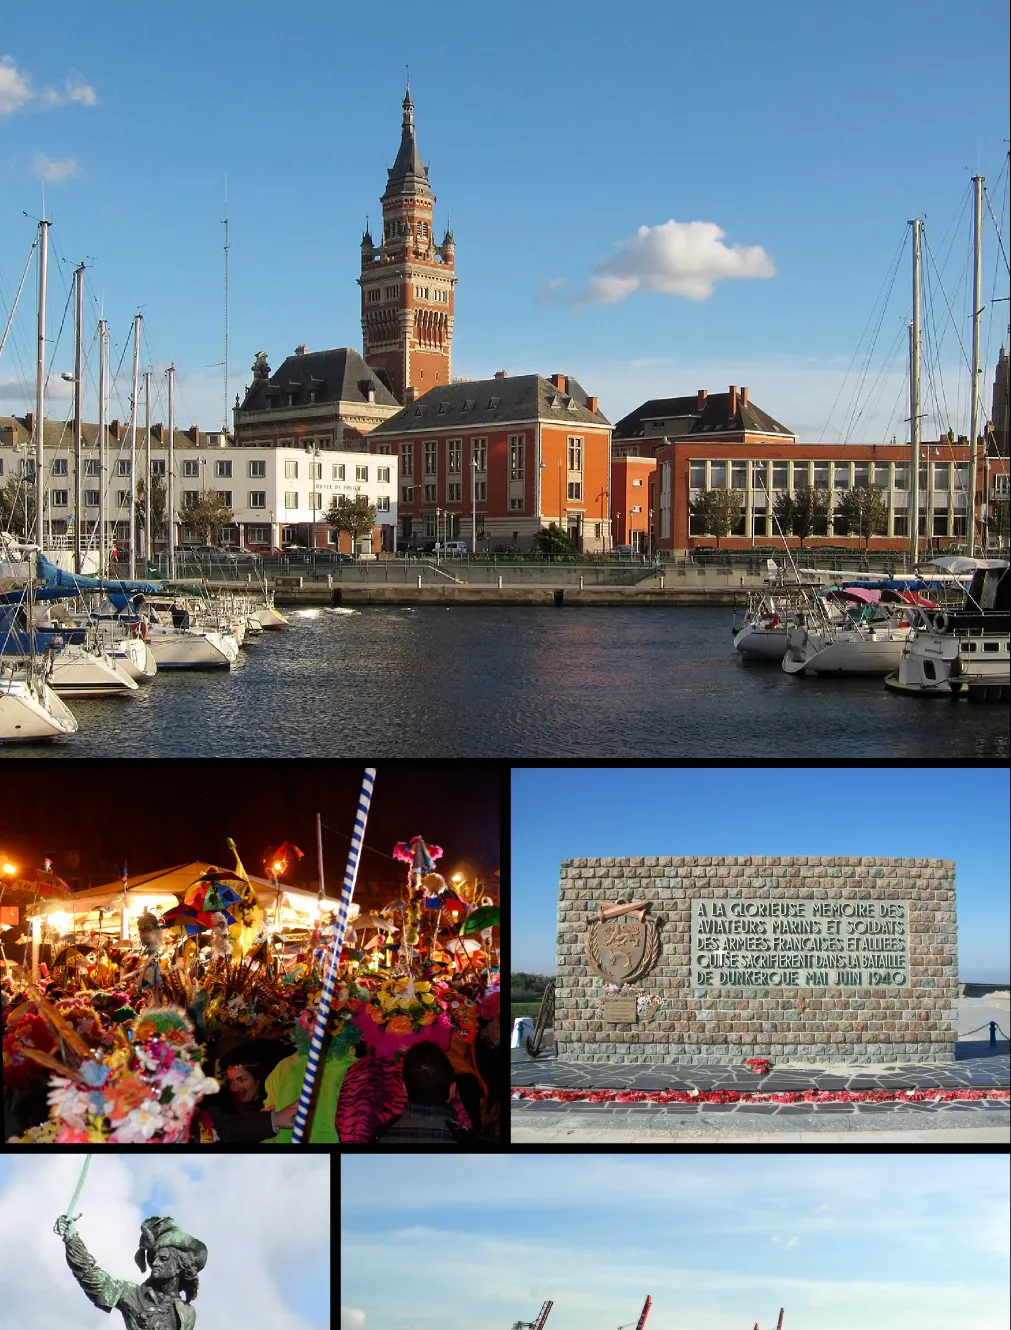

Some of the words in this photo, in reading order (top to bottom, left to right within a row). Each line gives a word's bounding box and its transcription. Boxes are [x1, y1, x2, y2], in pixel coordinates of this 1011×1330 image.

[697, 903, 707, 917] A
[711, 903, 726, 917] LA
[730, 902, 805, 917] GLORIEUSE
[812, 902, 876, 917] MEMOIRE
[879, 902, 905, 917] DES
[697, 919, 767, 935] AVIATEURS
[771, 919, 822, 935] MARINS
[826, 919, 842, 935] ET
[845, 919, 906, 935] SOLDATS
[696, 936, 720, 951] DES
[722, 936, 771, 952] ARMEES
[846, 936, 861, 952] ET
[861, 936, 906, 952] ALLIEES
[723, 953, 739, 969] SE
[740, 953, 814, 969] SACRIFIERENT
[814, 953, 847, 969] DANS
[847, 953, 862, 969] LA
[862, 953, 906, 969] BATAILLE
[696, 970, 714, 986] DE
[719, 970, 800, 986] DUNKERQUE
[804, 971, 830, 986] MAI
[833, 971, 863, 986] JUIN
[867, 971, 907, 986] 1940
